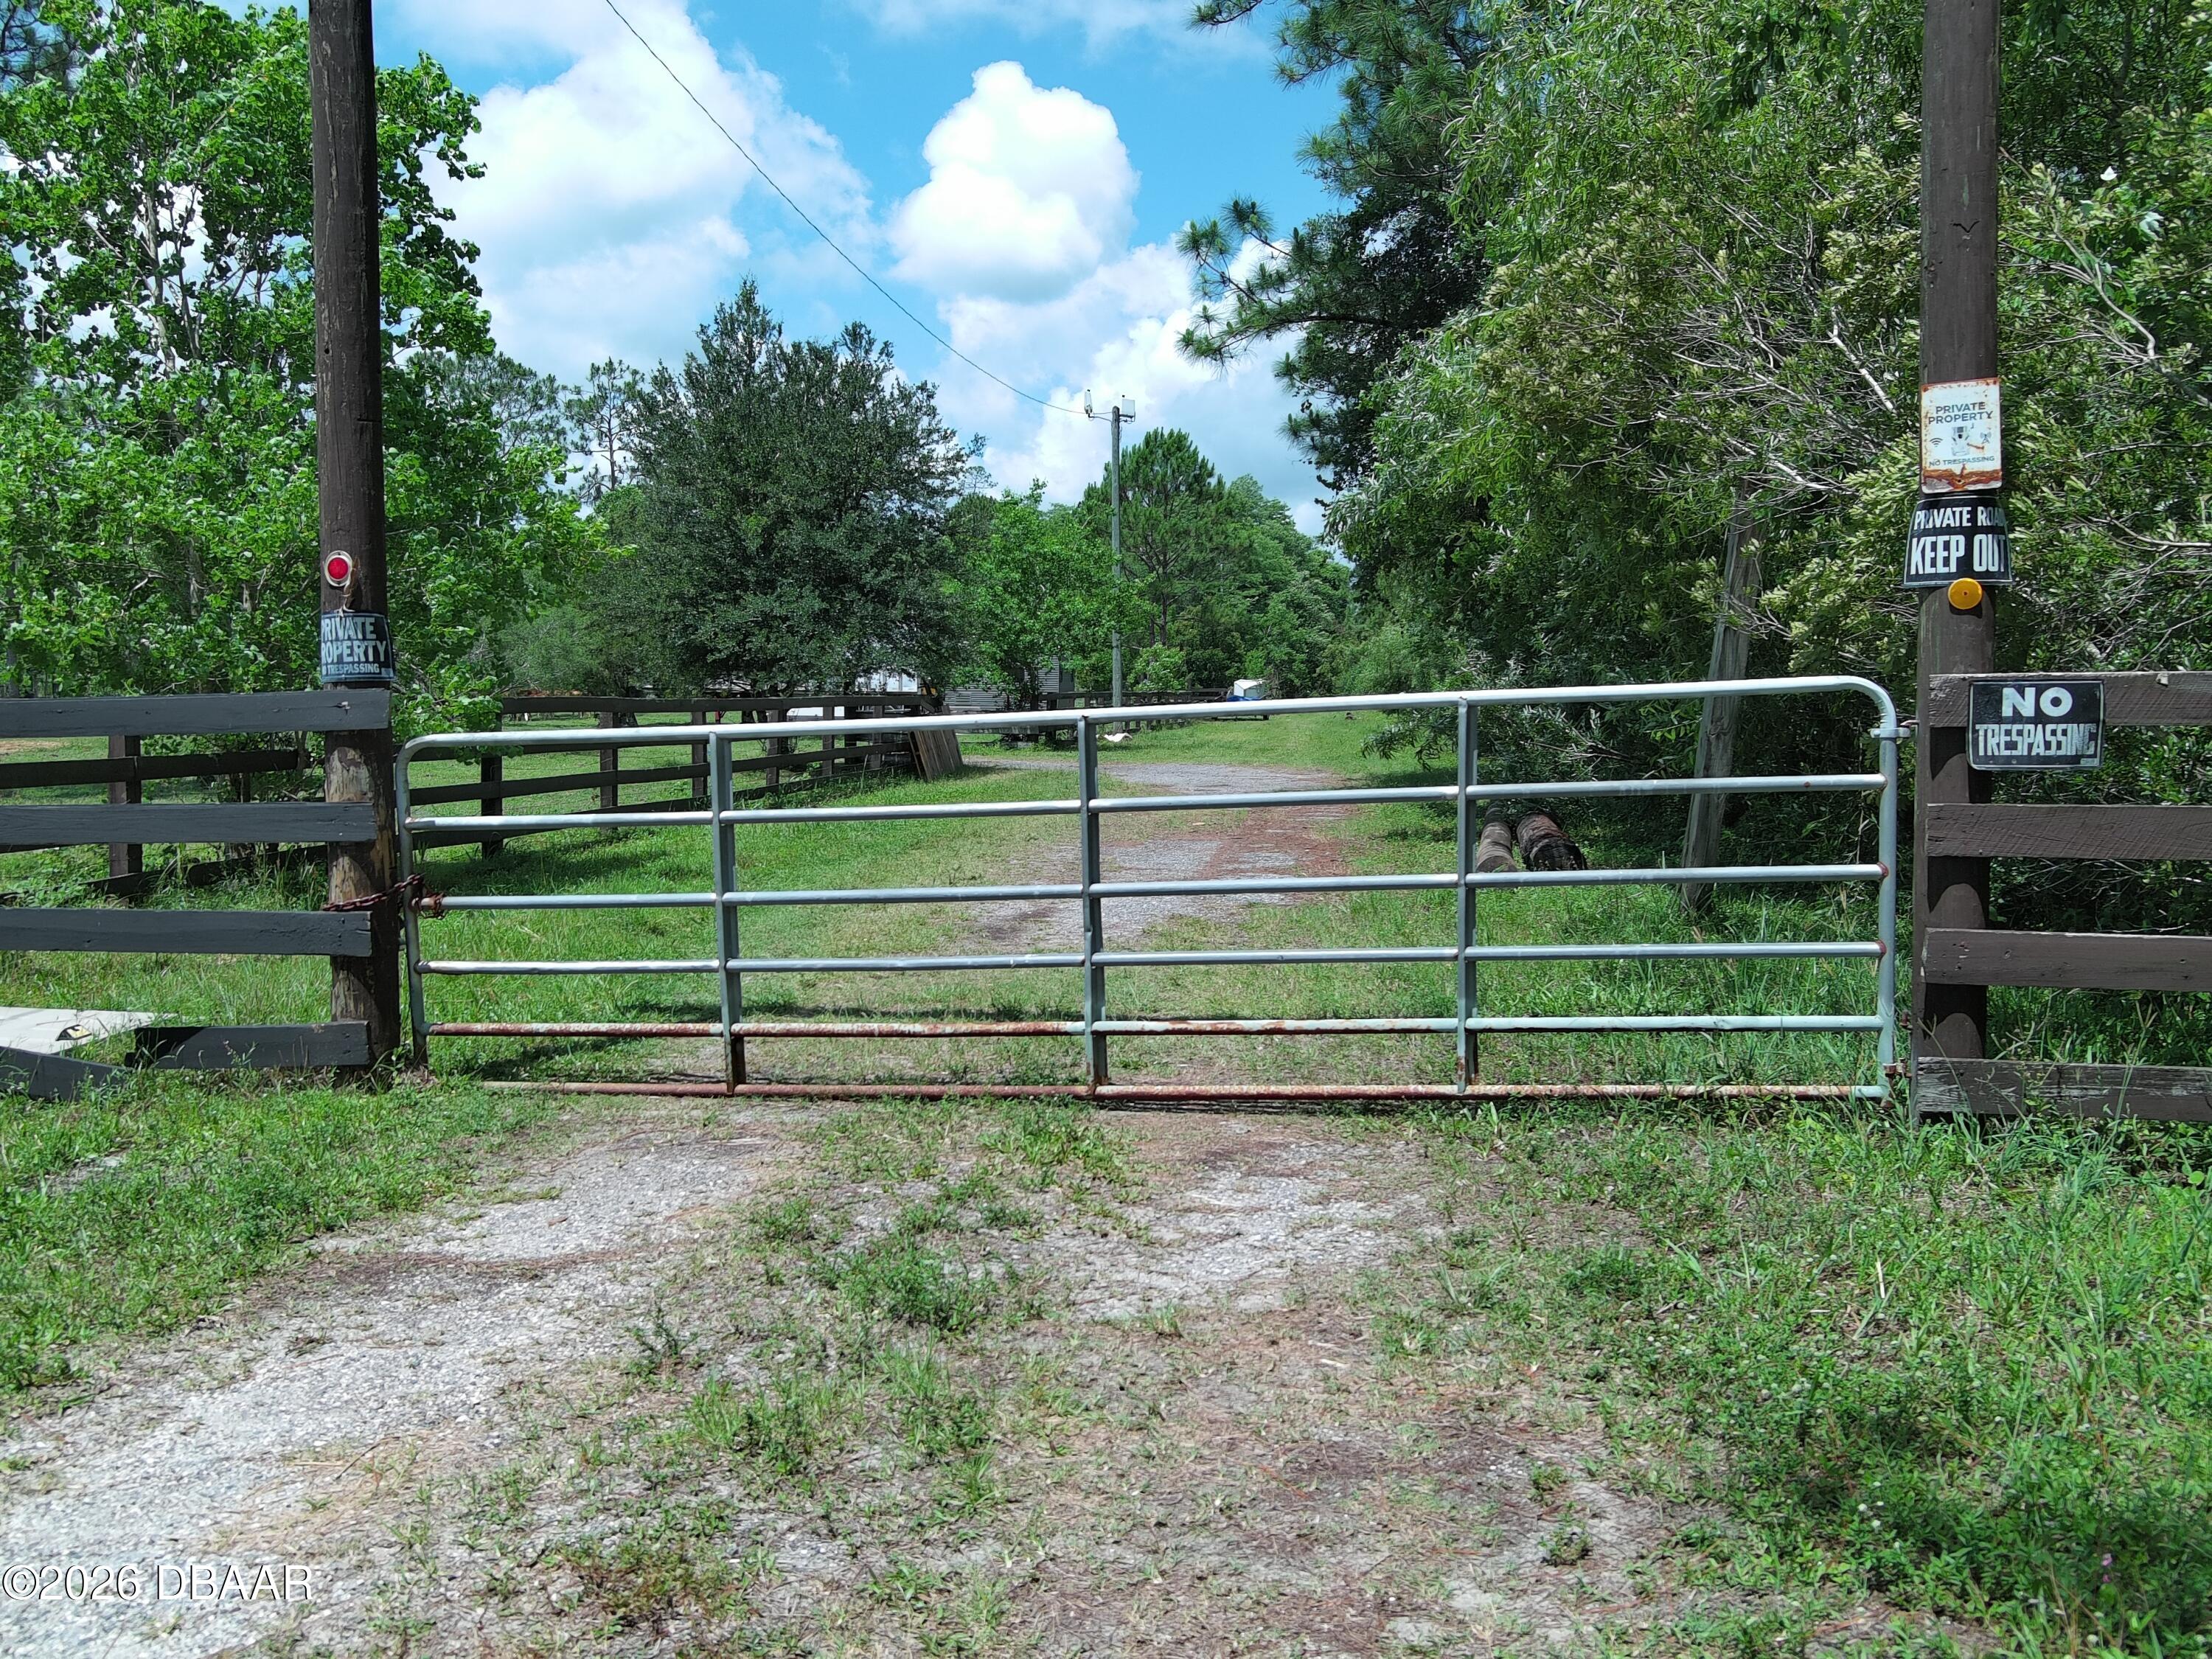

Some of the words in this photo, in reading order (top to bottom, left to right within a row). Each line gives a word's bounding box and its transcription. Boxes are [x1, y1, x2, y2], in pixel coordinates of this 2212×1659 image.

[1928, 411, 1994, 425] PROPERTY
[1935, 401, 1986, 414] PRIVATE
[1943, 456, 1995, 466] TRESPASSING
[1913, 507, 1972, 530] PRIVATE
[1910, 535, 1965, 575] KEEP
[1973, 534, 2006, 572] OUT
[321, 640, 387, 664] ROPERTY
[327, 663, 380, 675] TRESPASSING
[2001, 686, 2073, 717] NO
[1975, 723, 2097, 756] TRESPASSING
